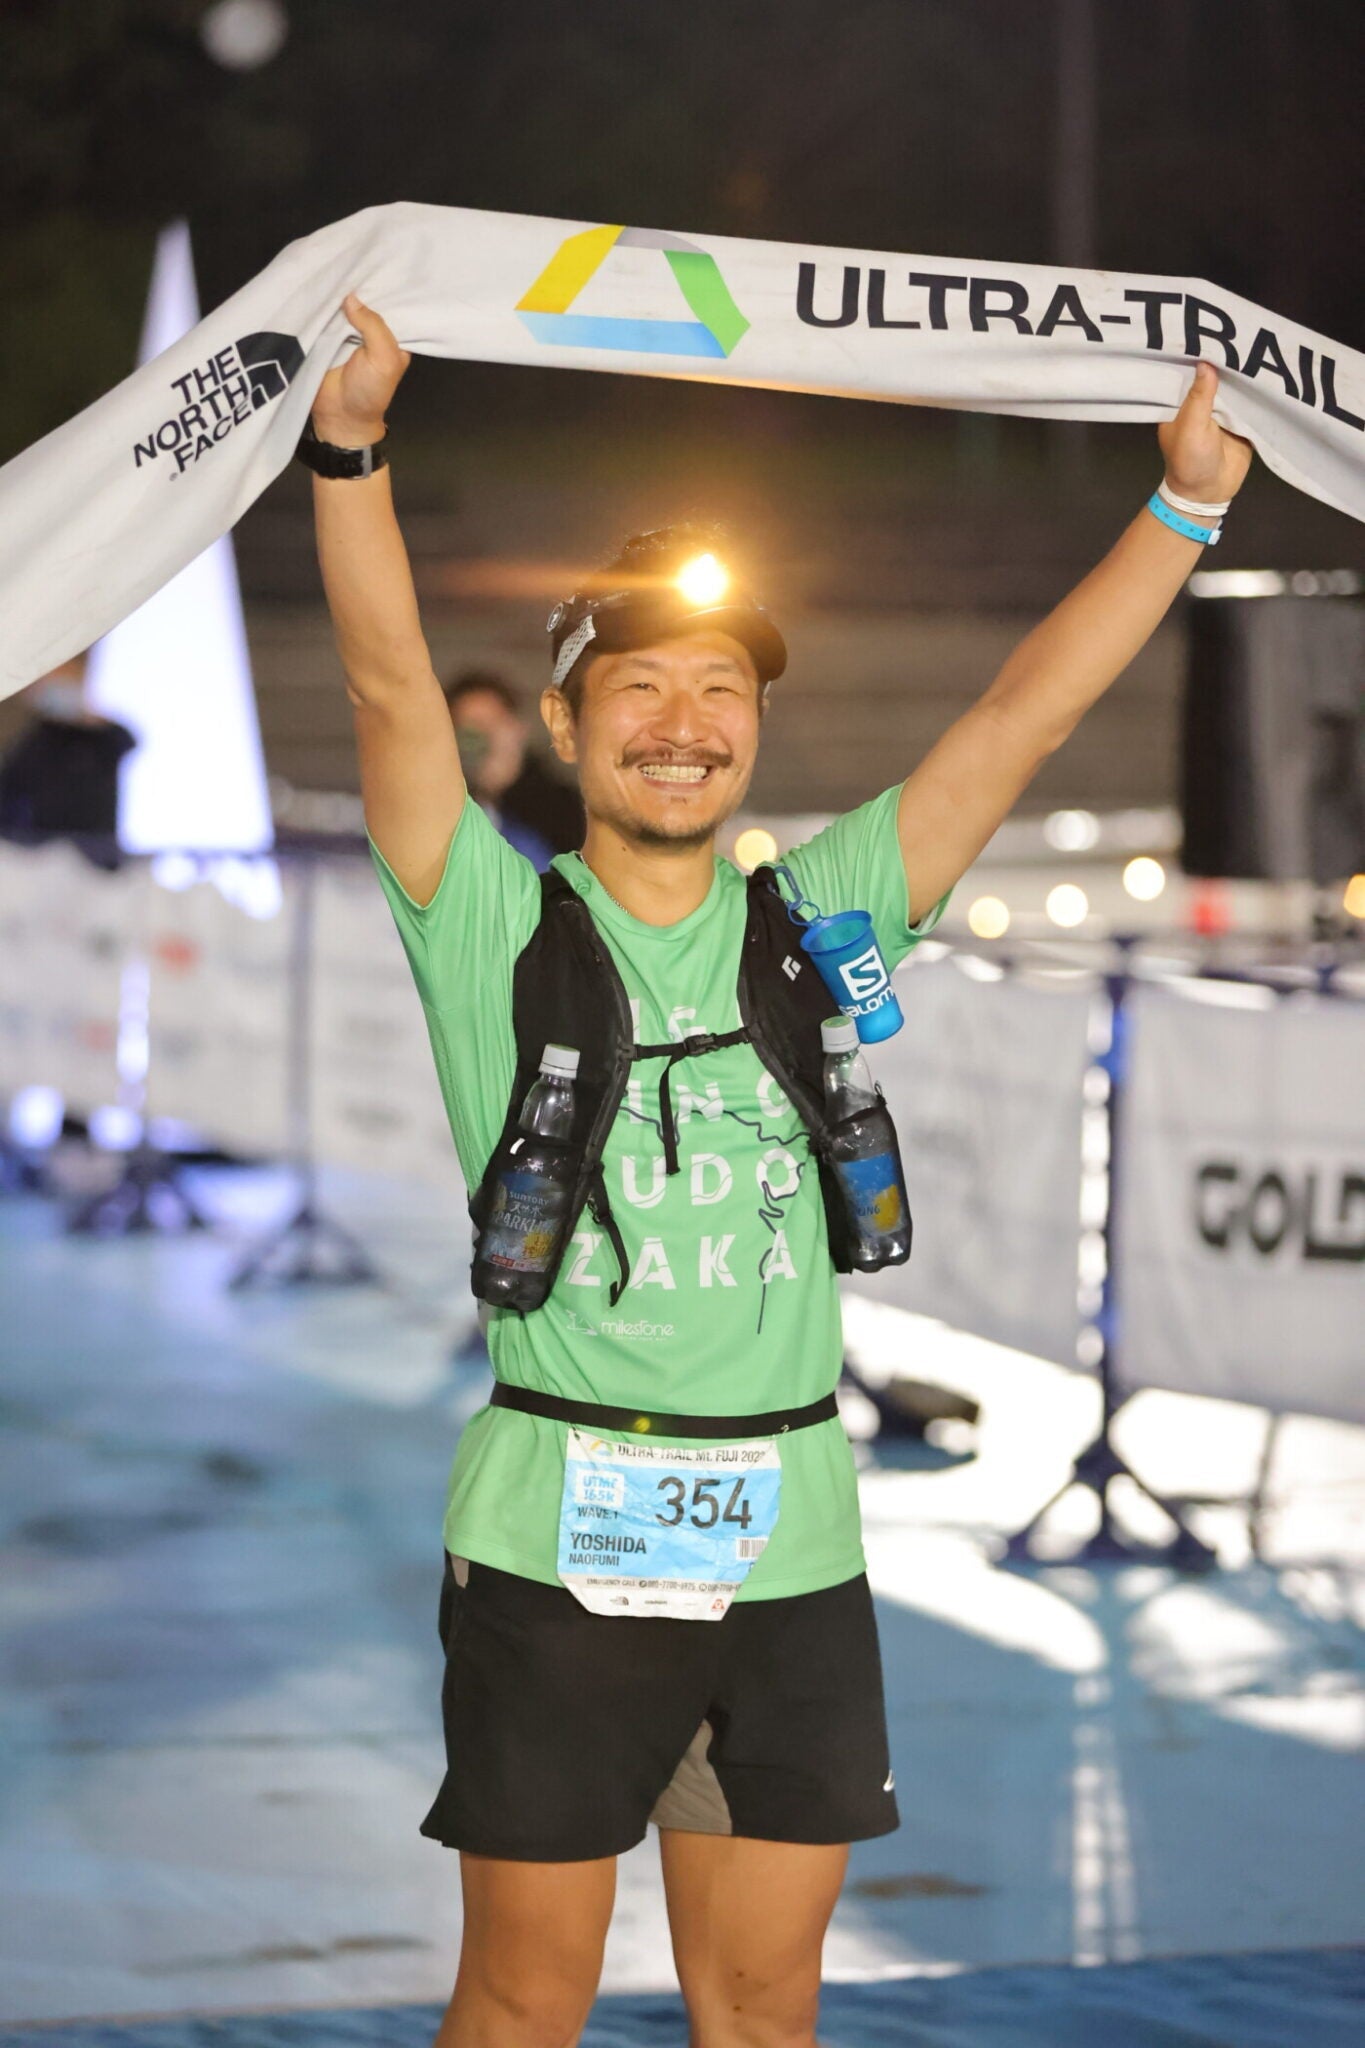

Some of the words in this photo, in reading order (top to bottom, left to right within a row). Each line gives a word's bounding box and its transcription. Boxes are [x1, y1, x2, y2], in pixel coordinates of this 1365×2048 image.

[797, 262, 1365, 431] ULTRA-TRAIL
[171, 346, 240, 405] THE
[133, 375, 250, 468] NORTH
[174, 401, 251, 473] FACE
[564, 1230, 798, 1290] ZAKA
[601, 1319, 674, 1337] milestone
[716, 1450, 738, 1462] FUJI
[655, 1476, 752, 1529] 354
[568, 1553, 620, 1566] NAOFUMI
[570, 1532, 647, 1554] YOSHIDA
